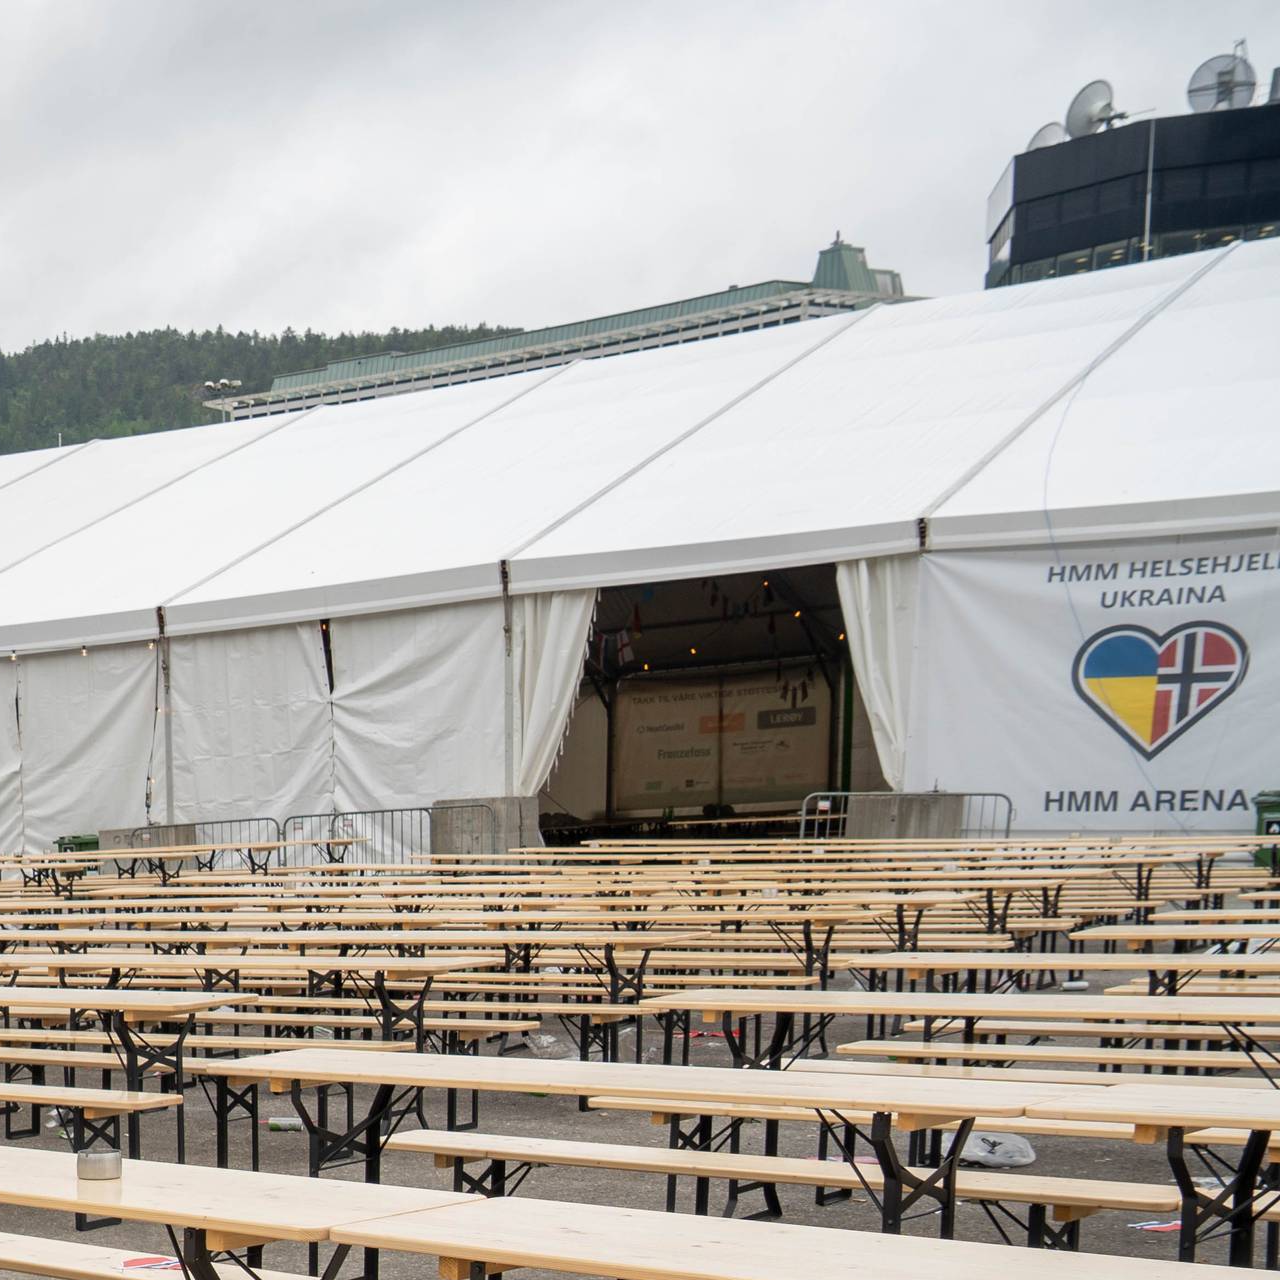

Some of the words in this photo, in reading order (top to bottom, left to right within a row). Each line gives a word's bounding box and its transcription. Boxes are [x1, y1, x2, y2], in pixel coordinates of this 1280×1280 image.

[1047, 562, 1119, 583] HMM
[1100, 585, 1226, 609] UKRAINA
[1044, 790, 1118, 812] HMM
[1129, 789, 1250, 812] ARENA
